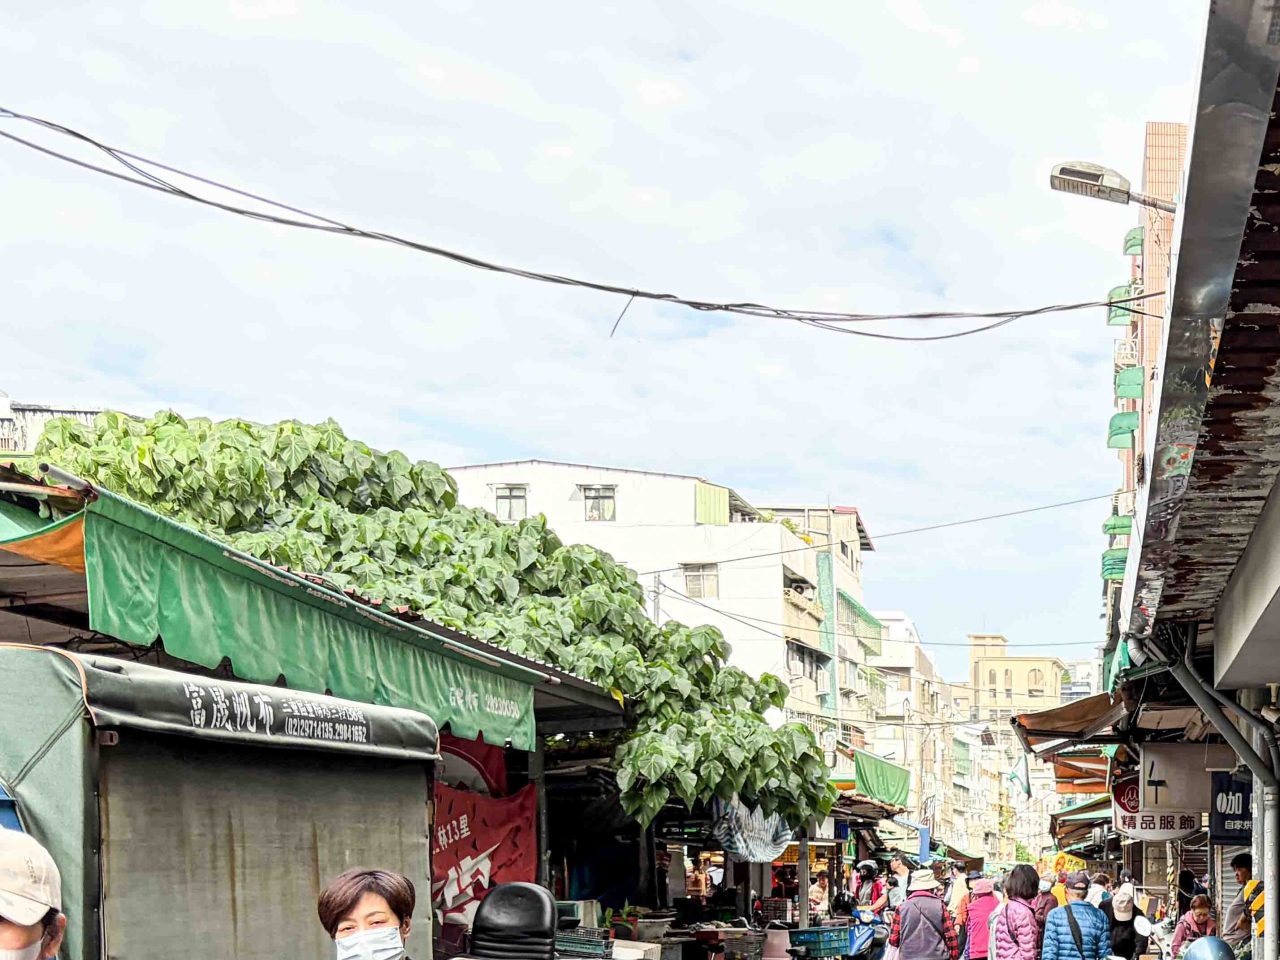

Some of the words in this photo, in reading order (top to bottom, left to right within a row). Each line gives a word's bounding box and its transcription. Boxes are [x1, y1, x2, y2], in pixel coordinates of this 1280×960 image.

[433, 813, 471, 855] 林13里
[1121, 814, 1196, 831] 精品服飾
